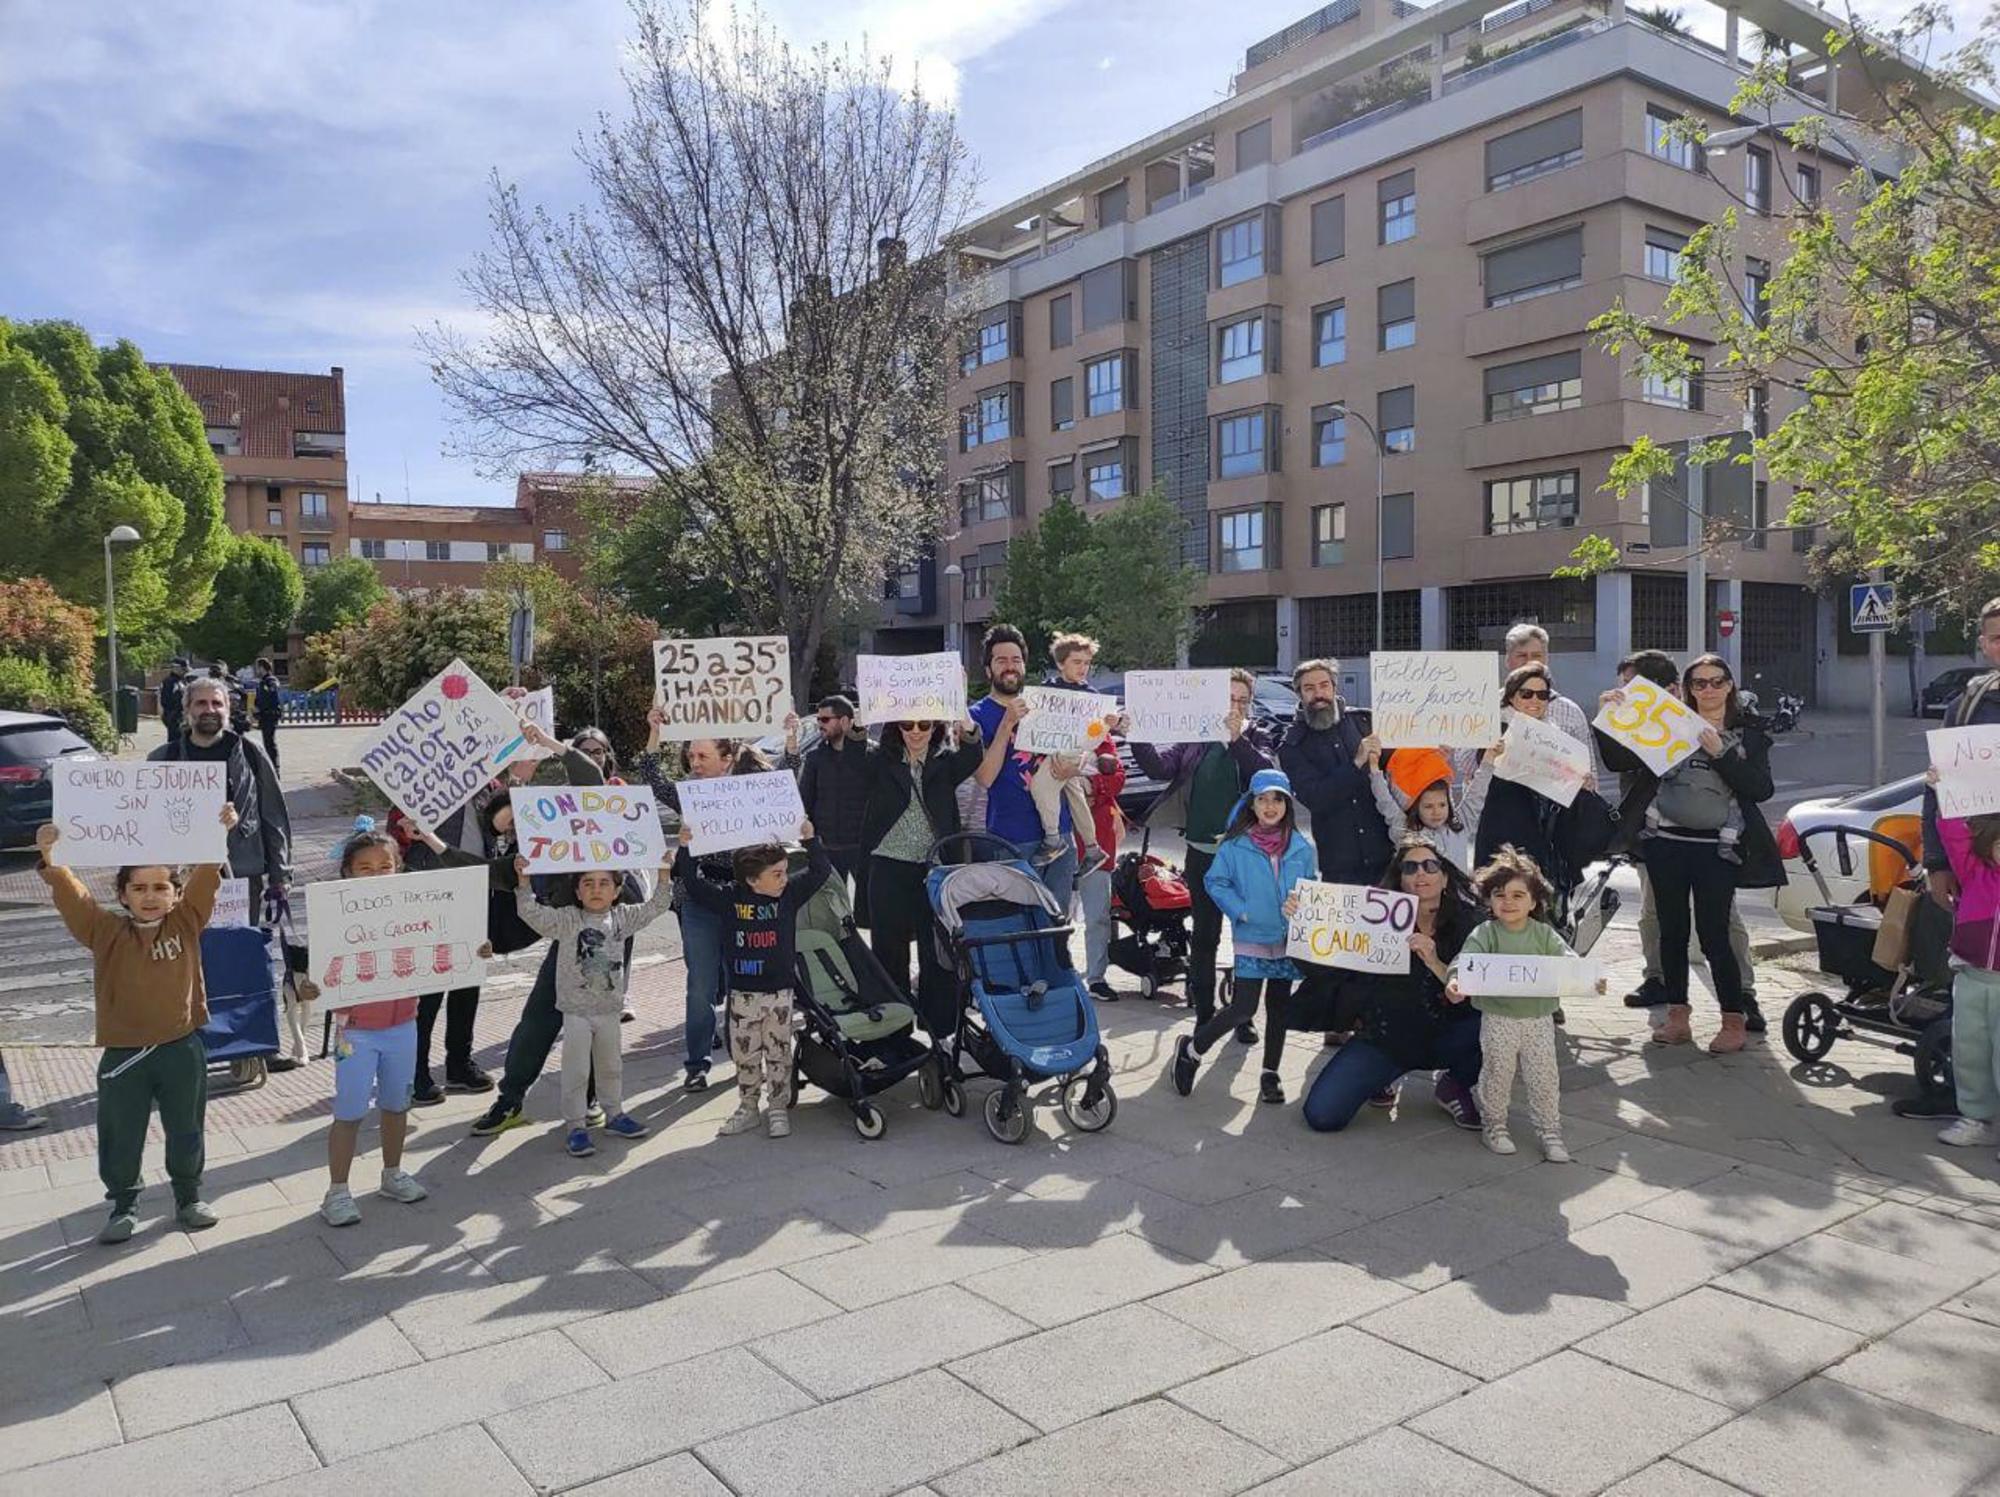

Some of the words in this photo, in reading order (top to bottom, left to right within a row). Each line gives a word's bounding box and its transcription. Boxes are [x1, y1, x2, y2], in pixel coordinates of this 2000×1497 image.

[659, 643, 699, 675] 25
[706, 652, 730, 676] a
[361, 700, 441, 773] mucho
[1030, 729, 1082, 749] VEGETAL
[384, 722, 446, 790] calor
[68, 769, 125, 790] QUIERO
[135, 765, 220, 791] ESTUDIAR
[403, 735, 481, 809] escuela
[420, 753, 490, 824] sudor
[519, 791, 650, 830] FONDOS
[701, 819, 744, 837] POLLO
[752, 811, 797, 828] ASADO
[67, 815, 144, 847] SUDAR
[569, 818, 603, 836] PA
[527, 831, 648, 863] TOLDOS
[735, 903, 755, 920] THE
[757, 902, 779, 920] SKY
[1343, 894, 1358, 909] DE
[1361, 889, 1414, 932] 50
[151, 934, 184, 961] HEY
[736, 930, 745, 948] IS
[746, 930, 777, 948] YOUR
[1291, 926, 1309, 943] DE
[1311, 927, 1371, 957] CALOR
[1382, 932, 1400, 945] EN
[734, 959, 765, 976] LIMIT
[1367, 947, 1401, 966] 2022
[1508, 965, 1539, 984] EN
